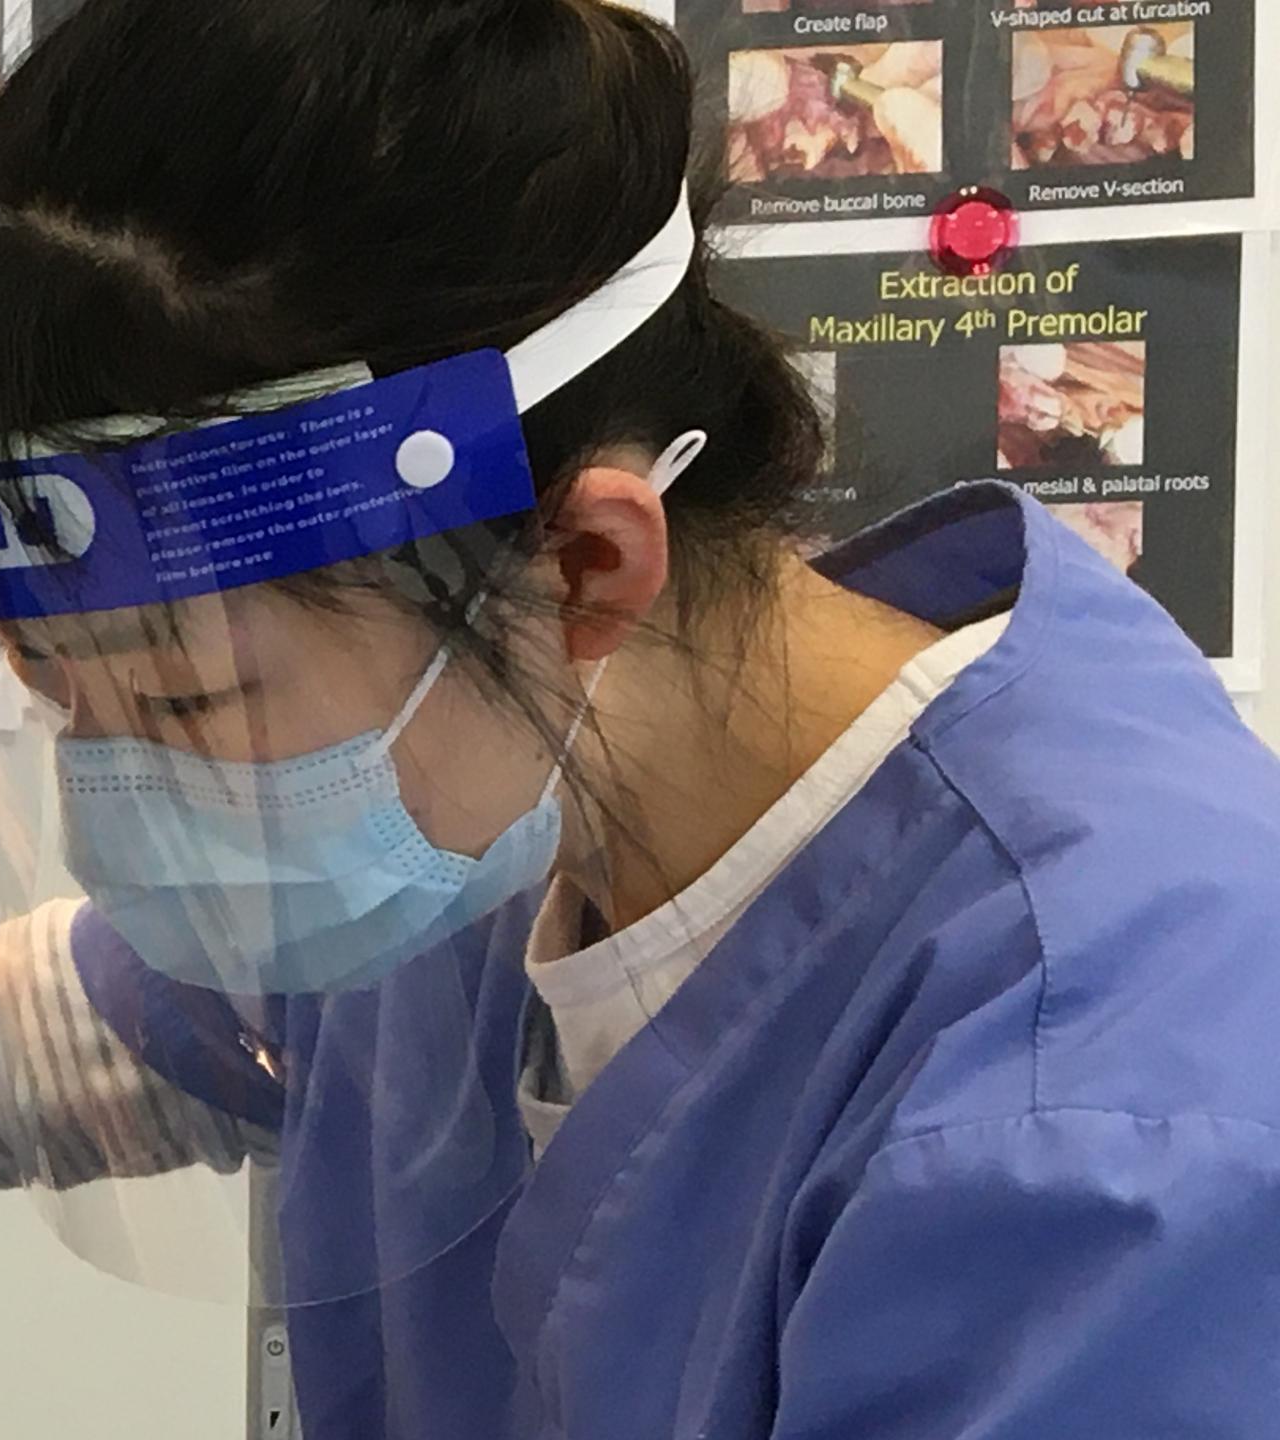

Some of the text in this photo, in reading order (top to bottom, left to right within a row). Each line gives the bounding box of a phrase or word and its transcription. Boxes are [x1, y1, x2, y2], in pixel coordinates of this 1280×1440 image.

[794, 13, 888, 34] Create flap
[990, 0, 1211, 28] V-shaped cut at furcation
[1029, 177, 1184, 202] Remove V-section
[751, 192, 927, 217] Remove buccal bone
[879, 263, 1079, 300] Extraction of
[809, 305, 1148, 347] Maxillary 4th Premolar
[299, 413, 345, 434] There
[347, 409, 361, 422] is
[364, 405, 375, 417] a
[221, 461, 254, 478] film
[256, 456, 277, 470] on
[280, 446, 306, 463] the
[309, 435, 352, 455] outer
[354, 422, 394, 442] layer
[261, 472, 304, 491] order
[306, 466, 325, 479] to
[1023, 476, 1079, 496] mesial
[1082, 477, 1097, 493] &
[1101, 474, 1161, 496] palatal
[1164, 473, 1210, 491] roots
[146, 520, 208, 542] prevent
[210, 500, 295, 528] scratching
[297, 490, 324, 505] the
[151, 486, 425, 562] please remove the outer protective
[190, 559, 242, 579] before
